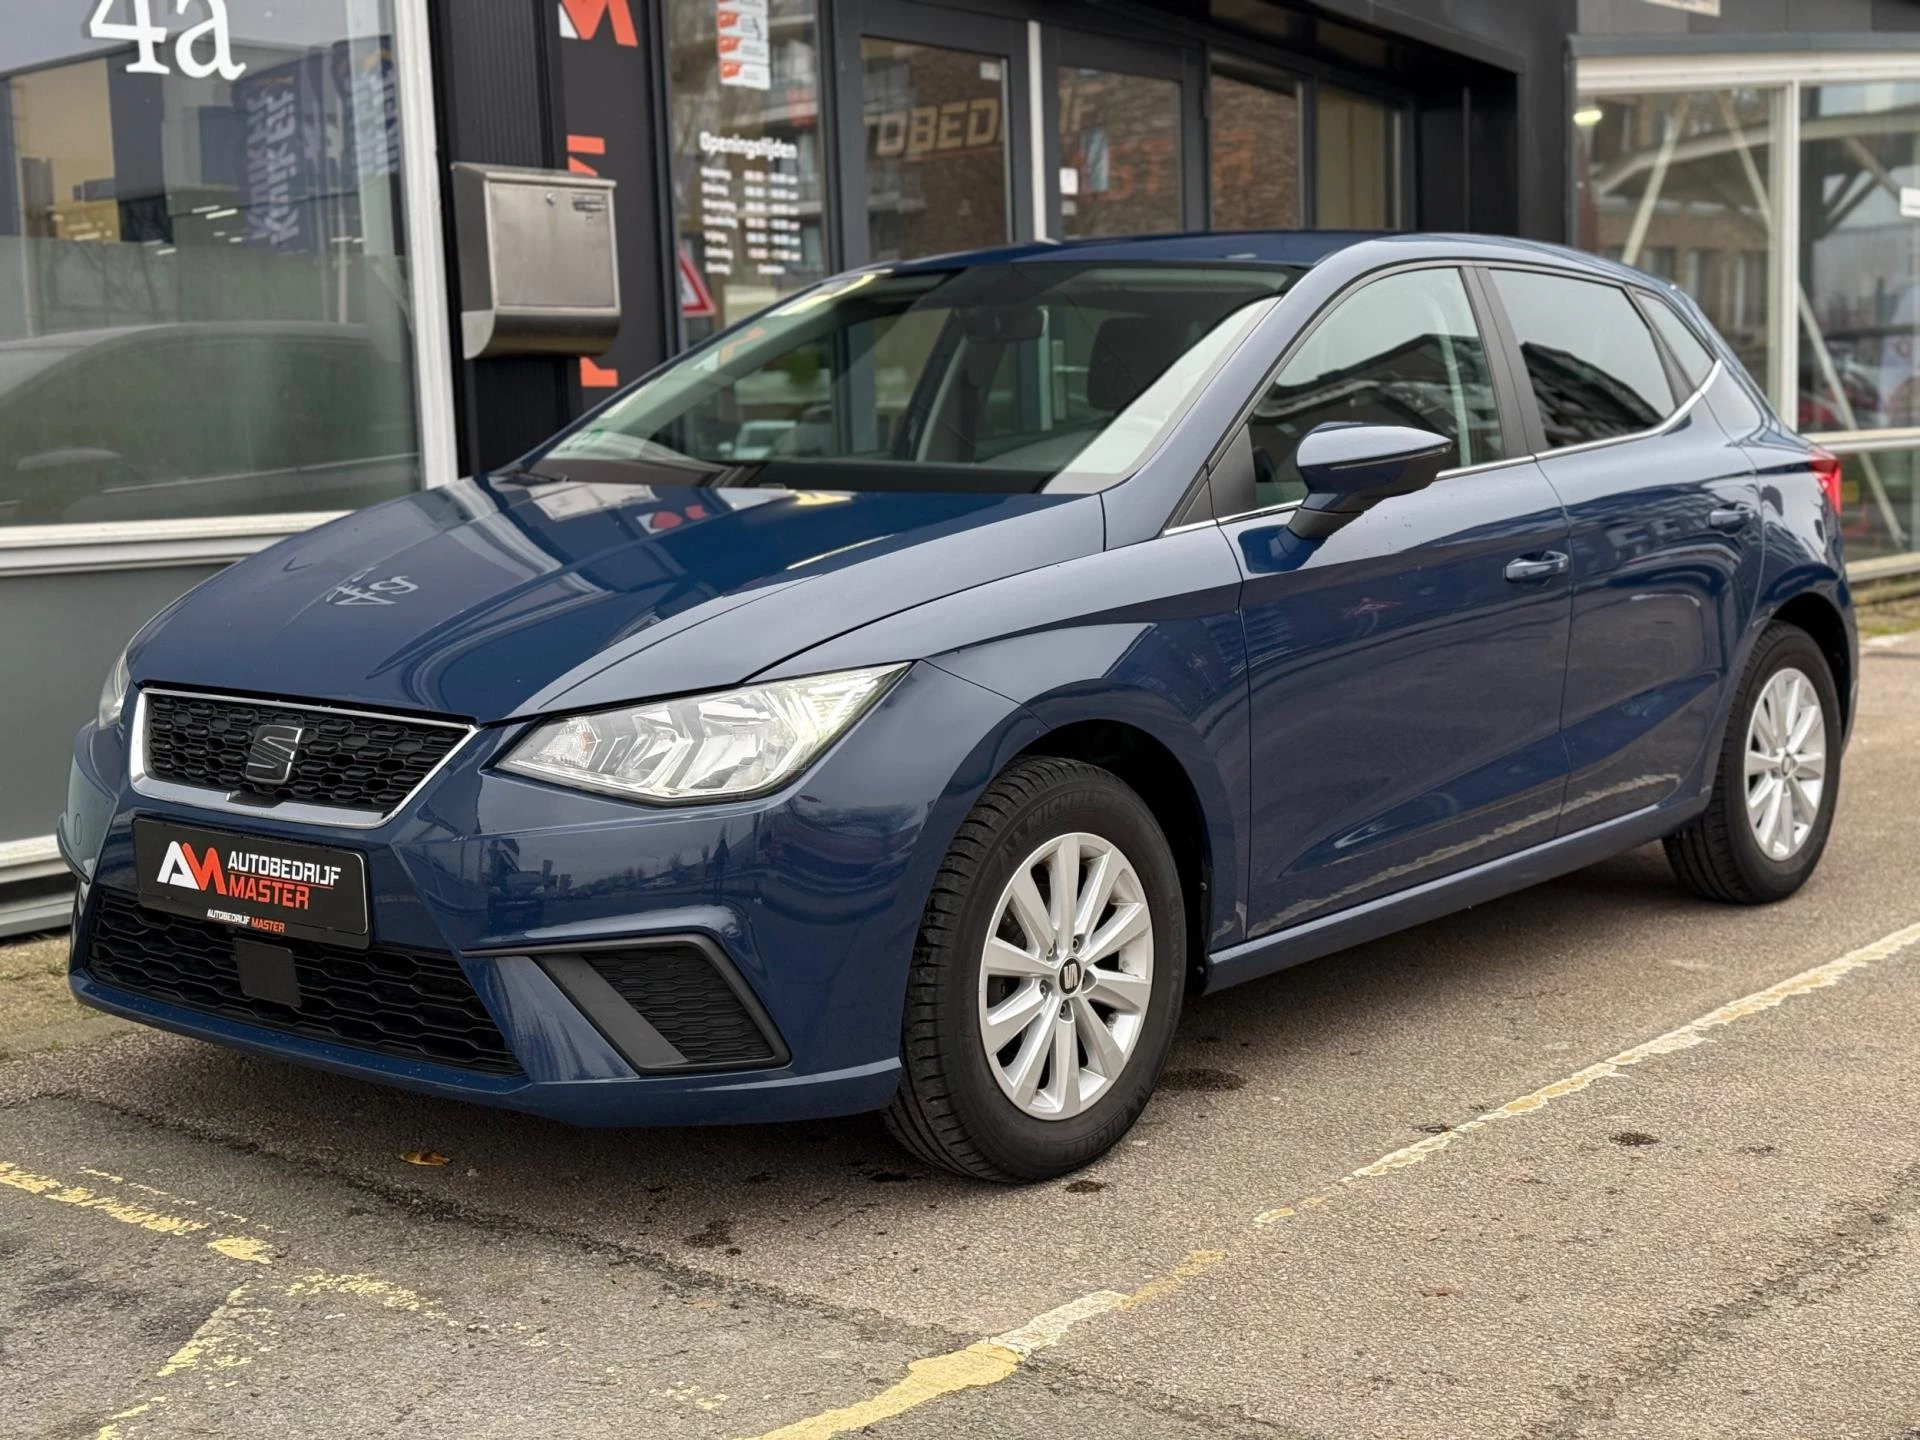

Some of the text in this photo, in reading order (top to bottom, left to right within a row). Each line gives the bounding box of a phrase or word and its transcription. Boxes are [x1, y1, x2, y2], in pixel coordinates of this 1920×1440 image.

[156, 840, 228, 895] AM
[227, 850, 342, 887] AUTOBEDRIJF
[228, 874, 311, 911] MASTER
[207, 908, 286, 934] AUTOBEDRIJF MASTER
